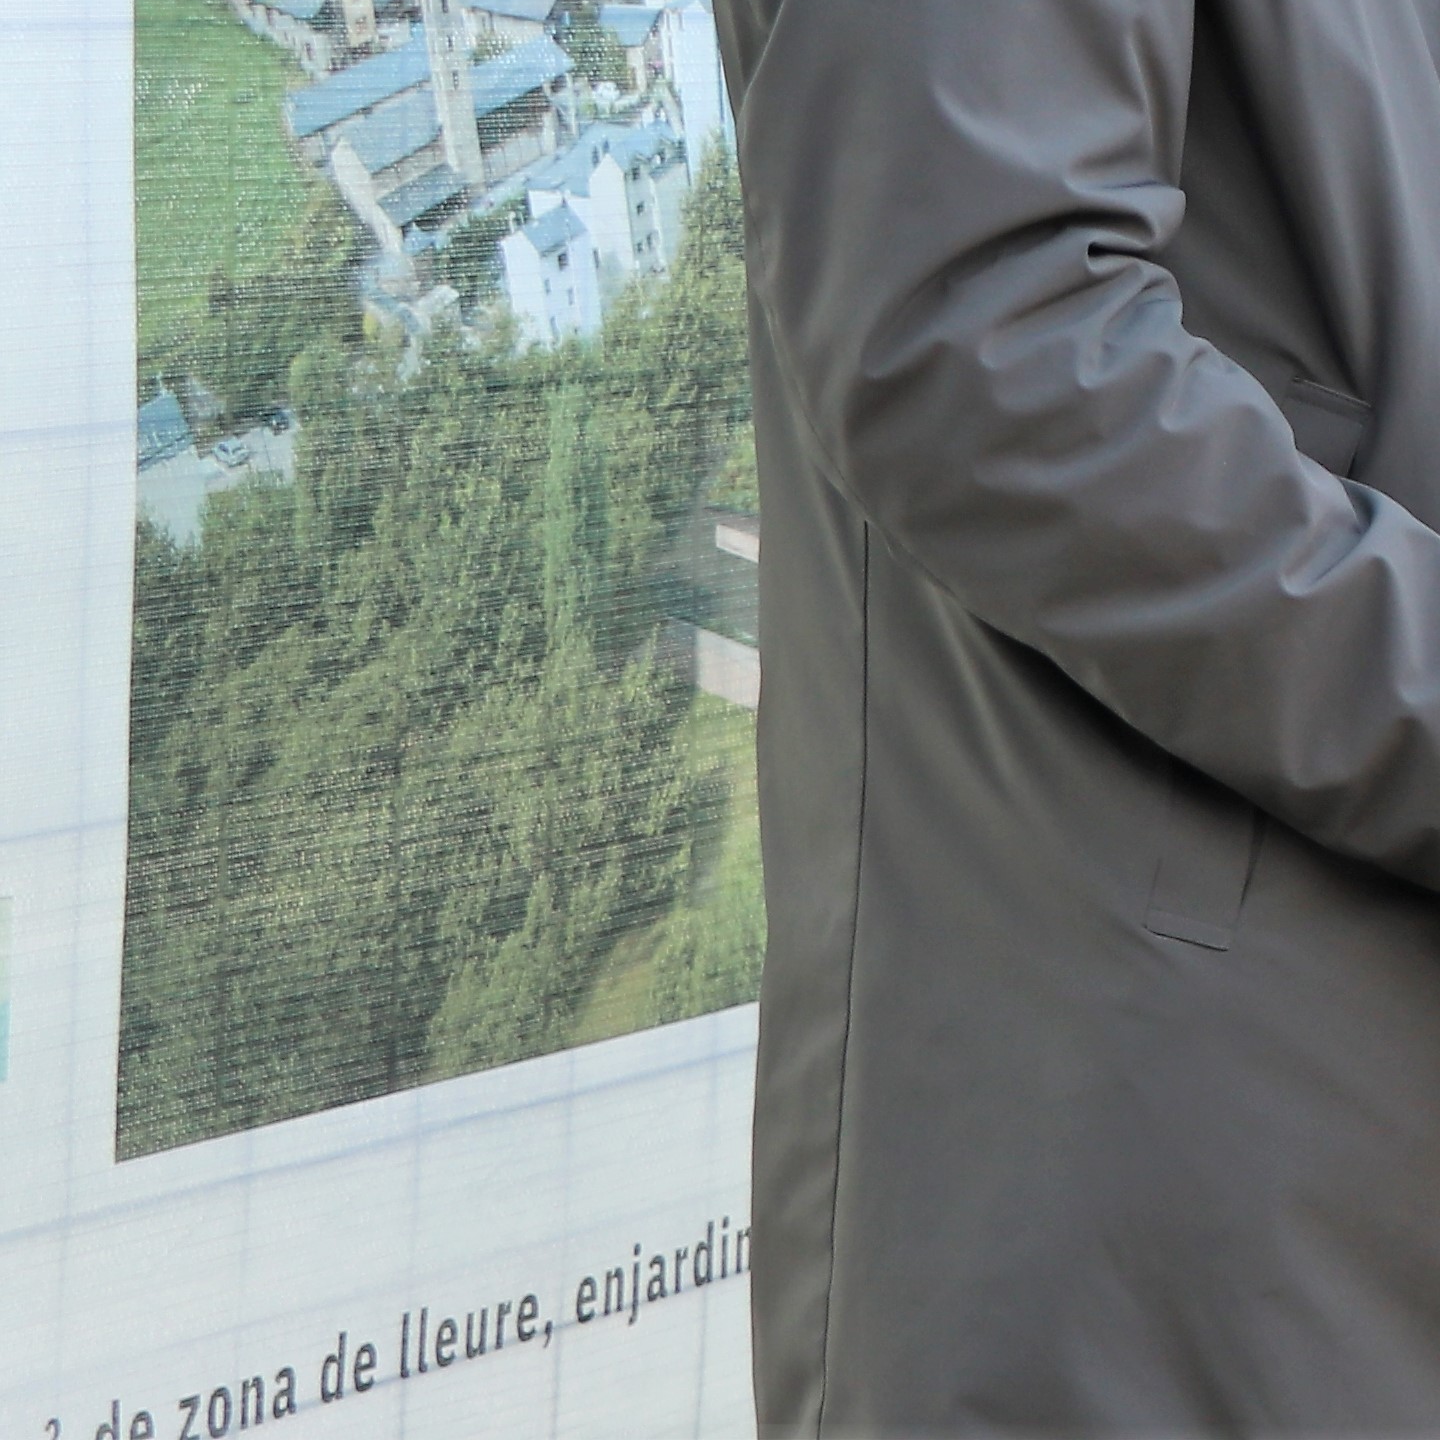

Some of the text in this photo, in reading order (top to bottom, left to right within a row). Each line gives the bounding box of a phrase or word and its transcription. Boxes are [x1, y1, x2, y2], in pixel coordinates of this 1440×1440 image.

[178, 1364, 298, 1440] zona
[320, 1329, 378, 1404] de
[399, 1304, 553, 1380] lleure,
